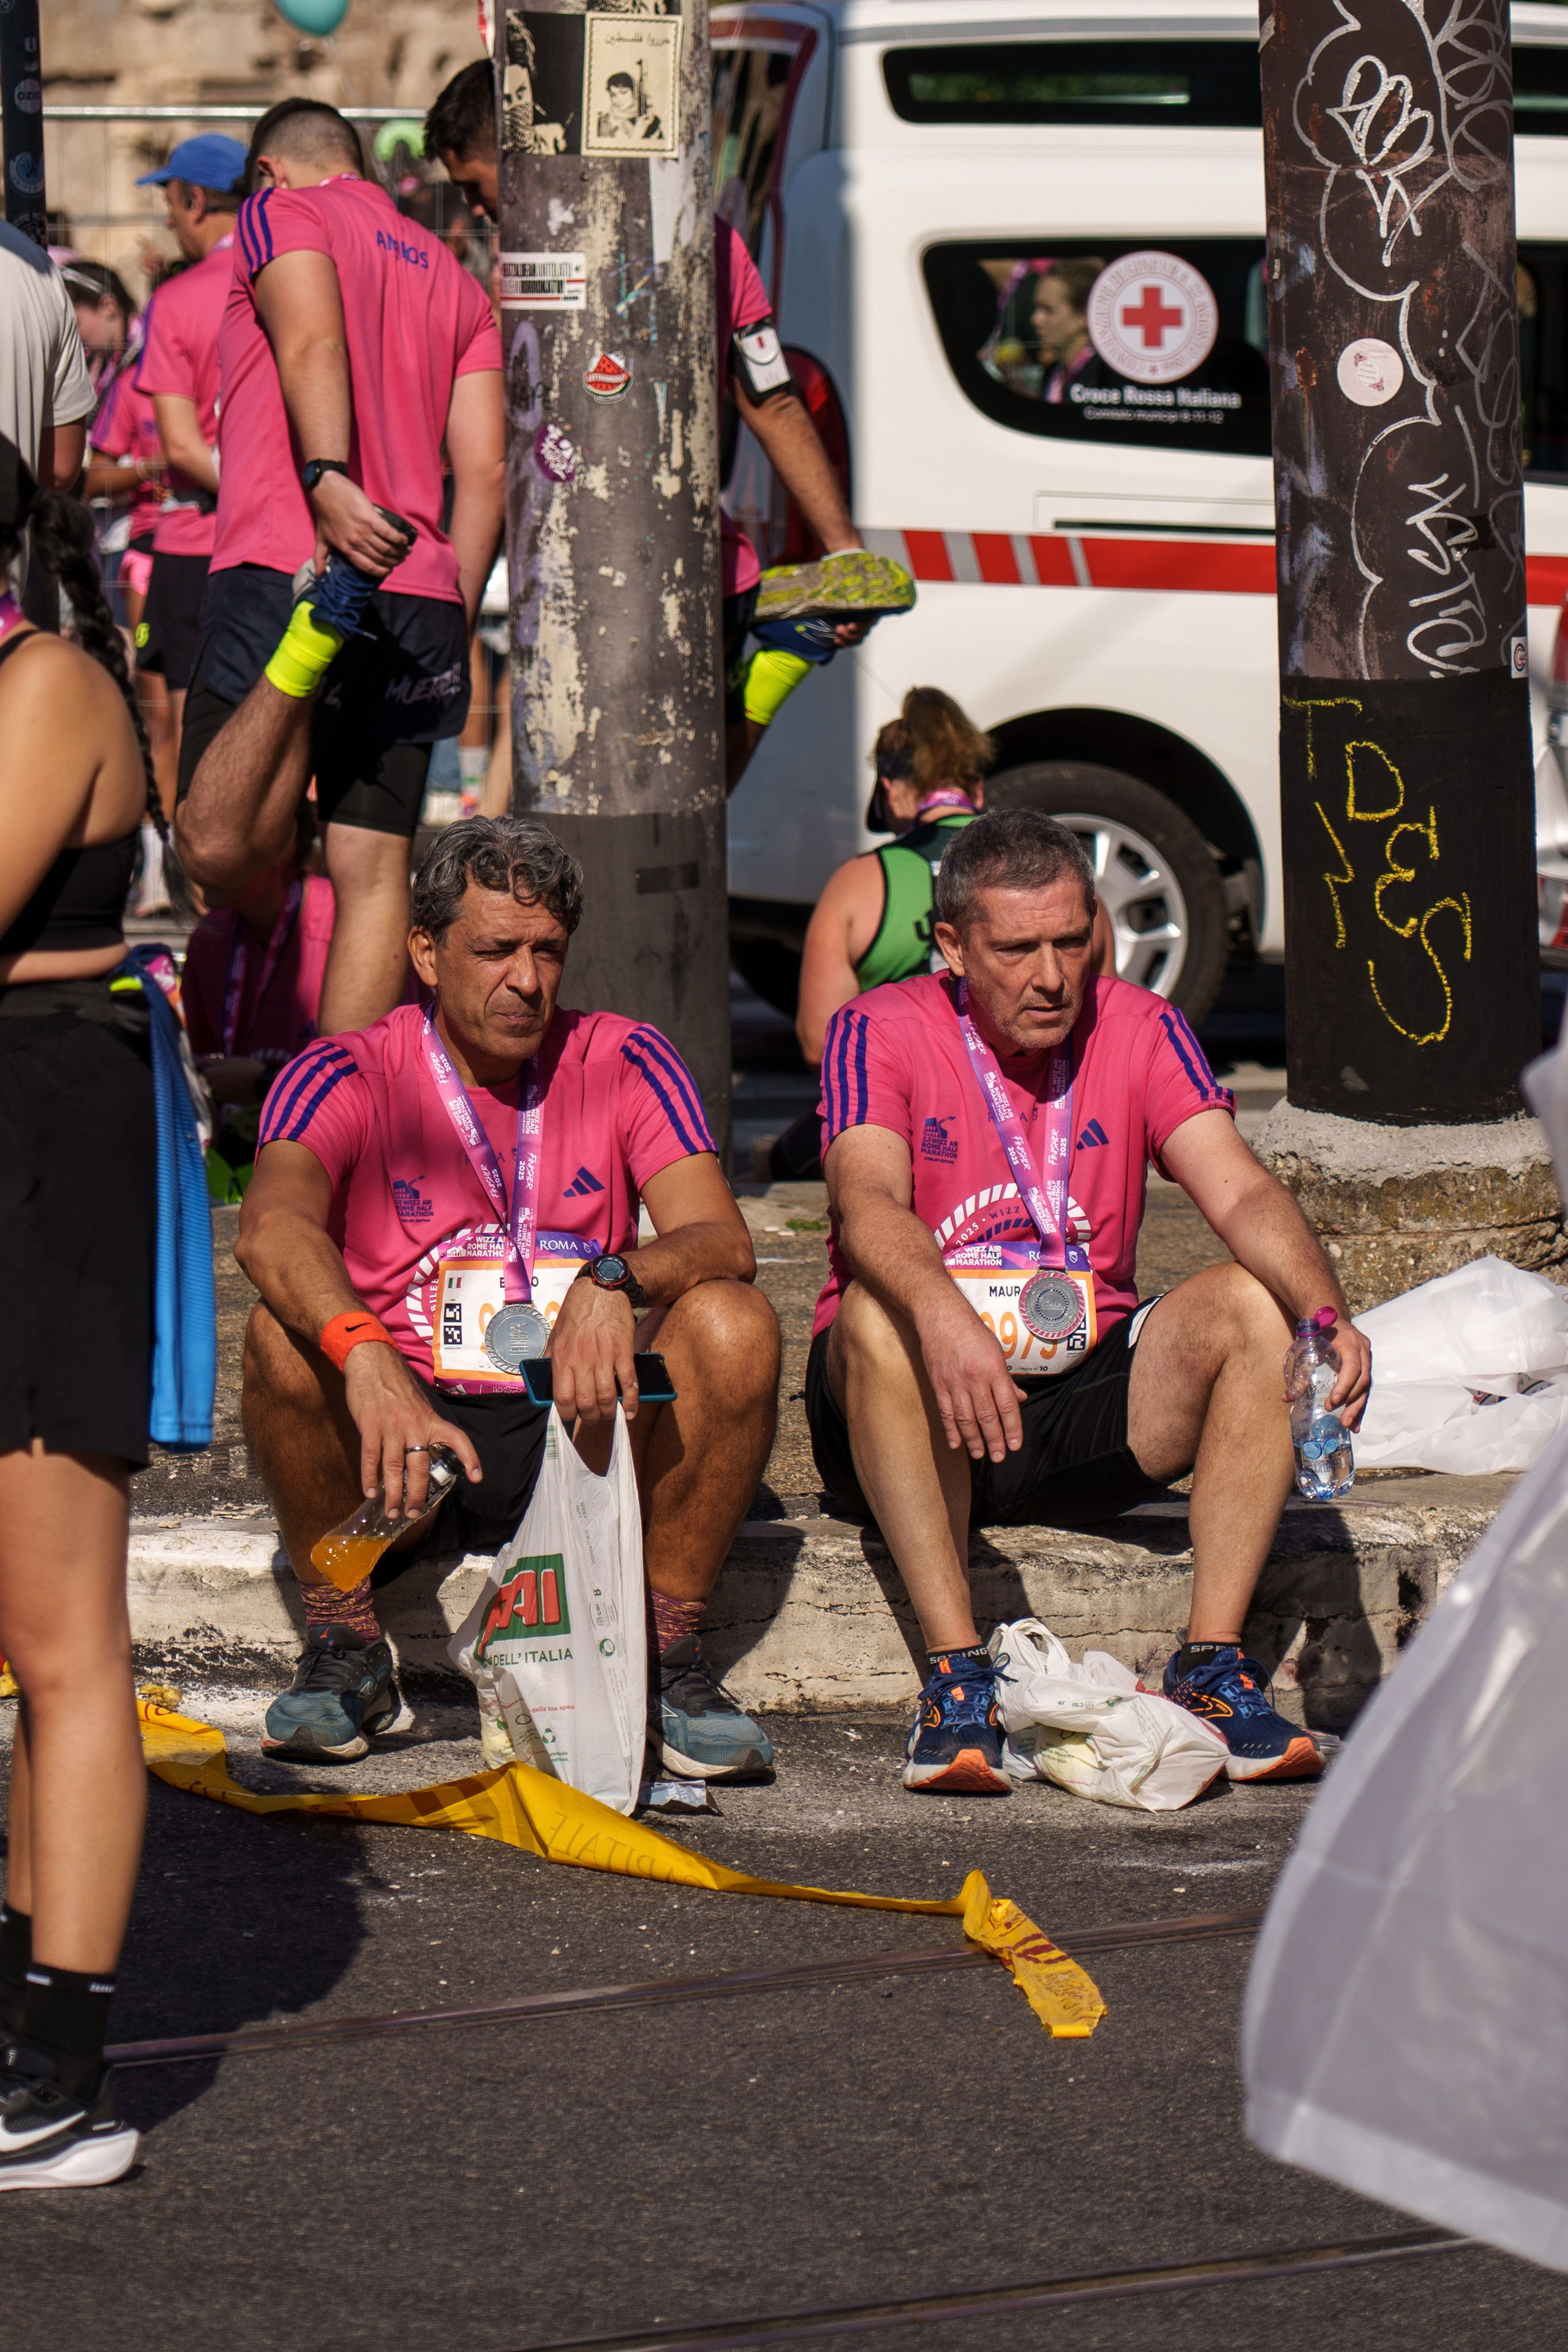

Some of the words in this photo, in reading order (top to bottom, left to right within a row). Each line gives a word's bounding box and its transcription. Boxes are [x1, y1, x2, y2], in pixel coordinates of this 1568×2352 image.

[1071, 384, 1121, 404] Croce
[1123, 385, 1175, 406] Rossa
[1177, 387, 1242, 409] Italiana
[965, 1033, 976, 1051] 2025
[430, 1050, 450, 1084] FINISHER
[440, 1054, 452, 1072] 2025
[448, 1099, 458, 1111] AIR
[453, 1099, 465, 1115] HALF
[990, 1088, 1005, 1121] MARATHON
[994, 1087, 1003, 1104] ROME
[1001, 1104, 1009, 1119] HALF
[1001, 1092, 1010, 1107] WIZZ
[453, 1110, 462, 1126] WIZZ
[458, 1096, 475, 1129] MARATHON
[459, 1114, 470, 1131] ROME
[921, 1148, 957, 1158] MARATHON
[1012, 1136, 1031, 1170] FINISHER
[1048, 1128, 1059, 1166] FINISHER
[1008, 1147, 1019, 1166] 2025
[491, 1169, 502, 1187] 2025
[525, 1152, 537, 1190] FINISHER
[481, 1164, 500, 1199] FINISHER
[1033, 1202, 1050, 1234] MARATHON
[1038, 1201, 1047, 1218] ROME
[1044, 1207, 1052, 1222] WIZZ
[956, 1222, 979, 1246] 2025
[989, 1205, 1020, 1219] WIZZ
[540, 1240, 578, 1251] ROMA
[990, 1286, 1021, 1297] MAUR
[930, 1648, 987, 1664] SPING
